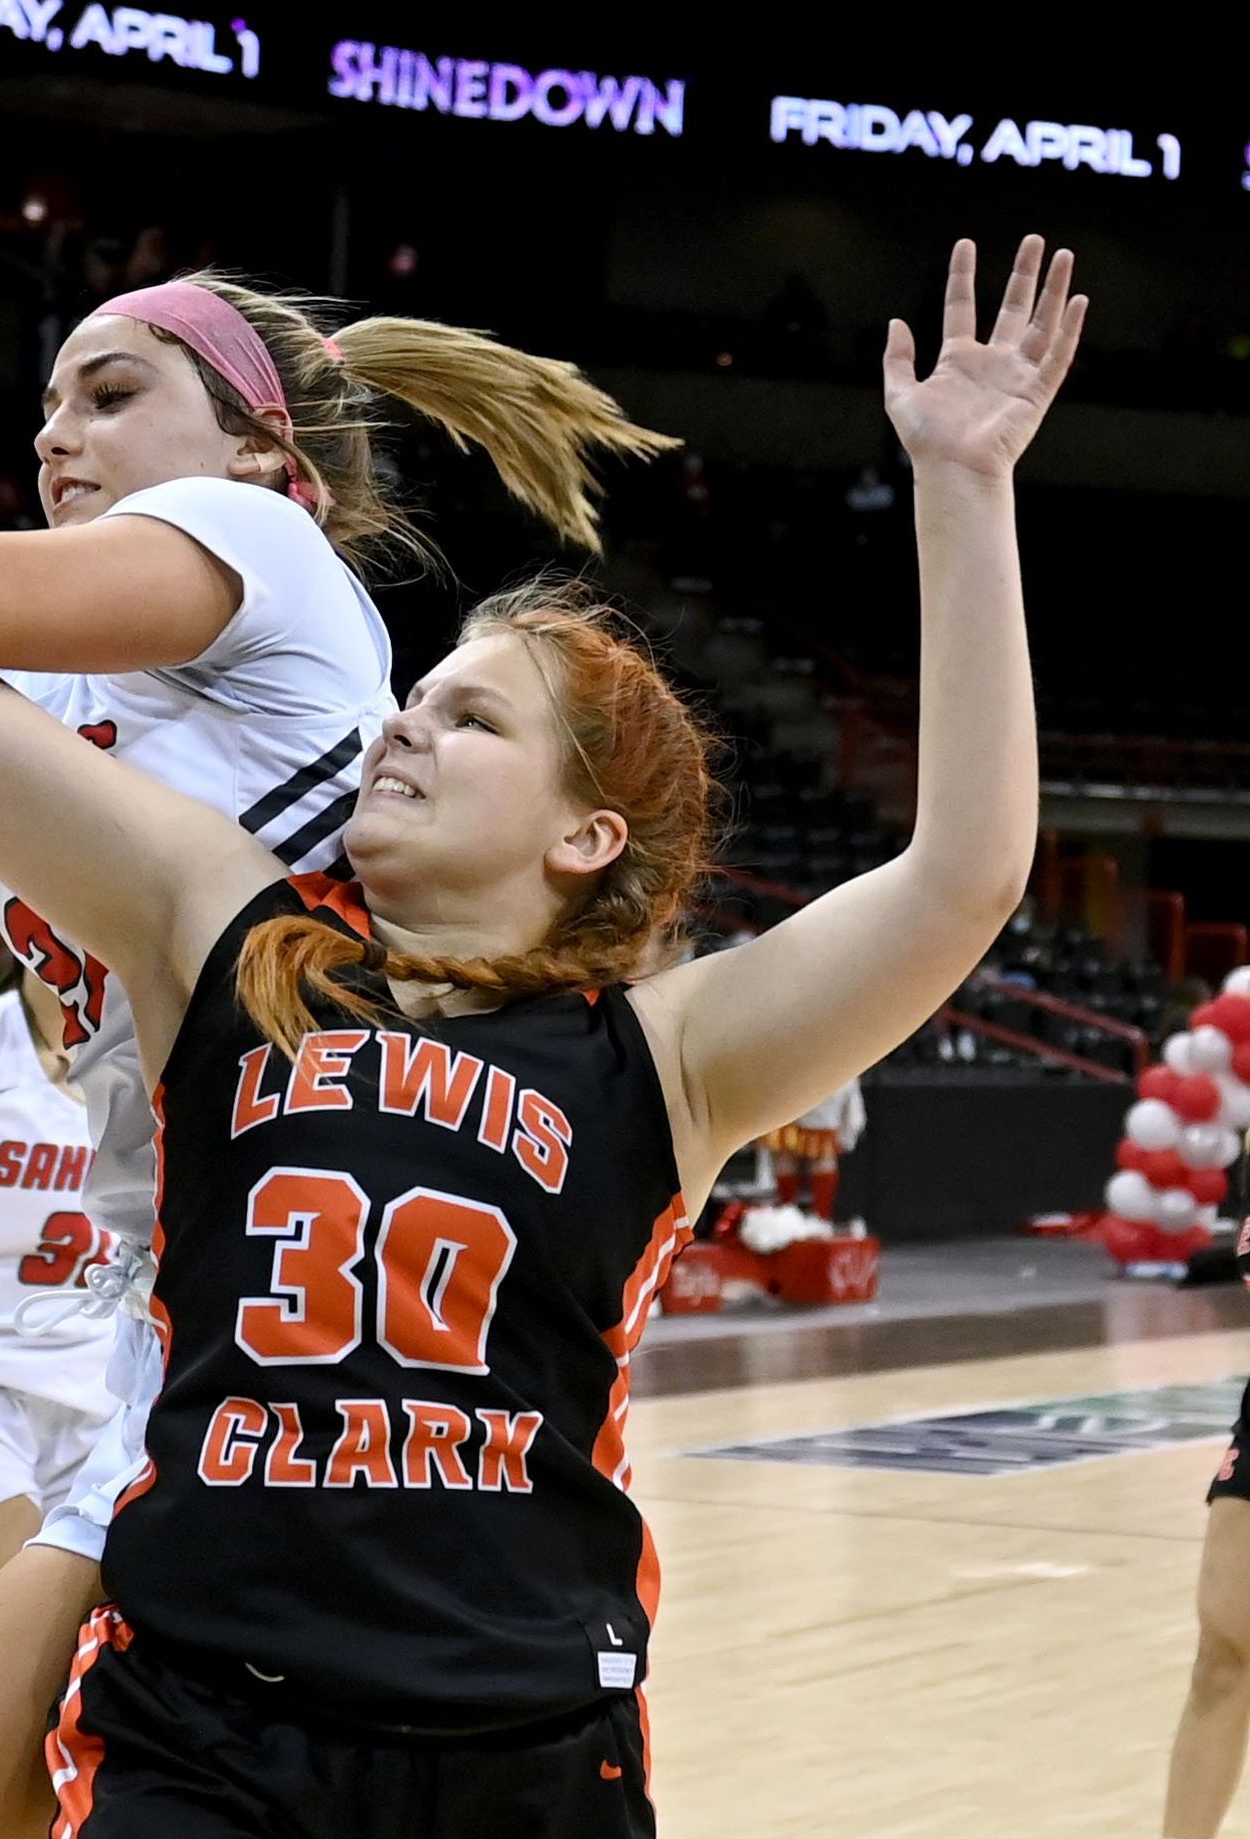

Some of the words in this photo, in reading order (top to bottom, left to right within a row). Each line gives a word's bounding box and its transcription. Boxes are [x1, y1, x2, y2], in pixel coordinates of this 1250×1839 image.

[70, 3, 233, 74] APRIL
[237, 29, 260, 78] 1
[328, 39, 685, 138] SHINEDOWN
[770, 96, 974, 166] FRIDAY,
[981, 118, 1152, 177] APRIL
[1156, 133, 1181, 180] 1
[231, 1030, 573, 1194] LEWIS
[234, 1166, 518, 1375] 30
[197, 1397, 544, 1494] CLARK
[606, 1623, 624, 1646] L
